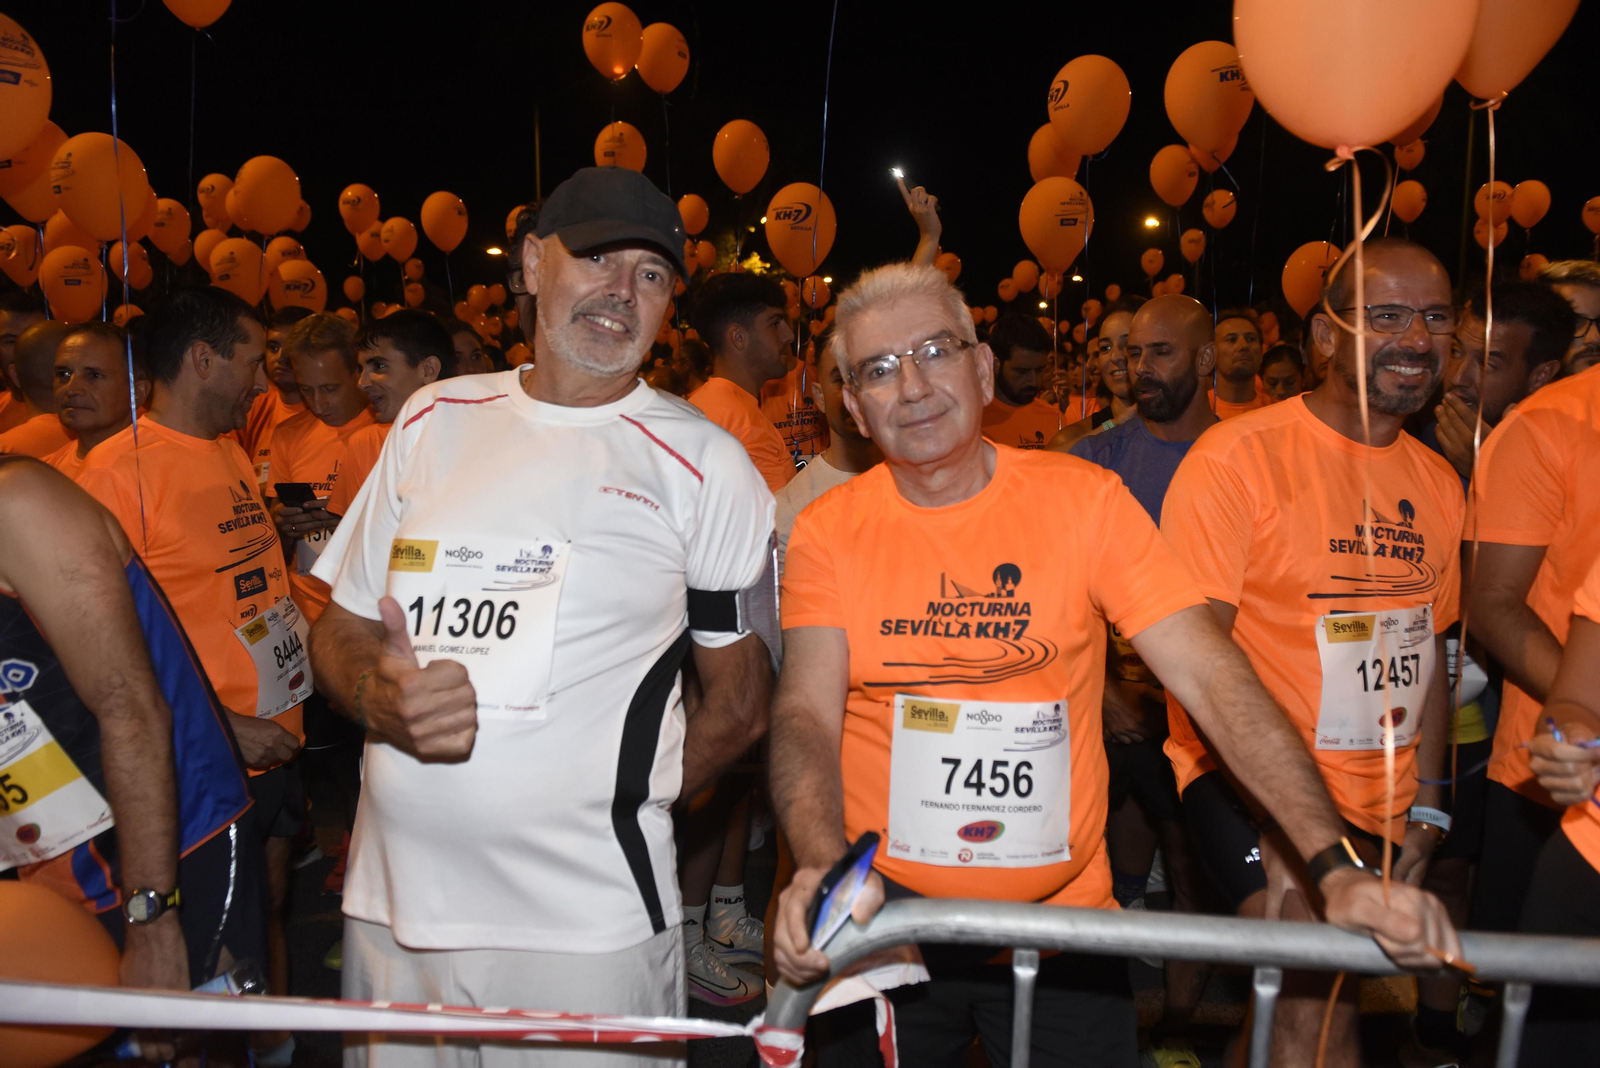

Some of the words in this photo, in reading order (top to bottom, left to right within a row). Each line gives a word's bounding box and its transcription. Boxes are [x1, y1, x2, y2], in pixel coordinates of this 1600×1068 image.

[495, 564, 531, 574] SEVILLA
[408, 595, 519, 640] 11306
[926, 602, 1031, 617] NOCTURNA
[880, 619, 971, 638] SEVILLA
[273, 630, 304, 669] 8444
[1357, 653, 1420, 692] 12457
[941, 756, 1034, 800] 7456
[920, 799, 961, 812] FERNANDO
[961, 804, 1006, 814] FERNANDEZ
[1007, 805, 1043, 814] CORDERO
[714, 896, 743, 905] FILA
